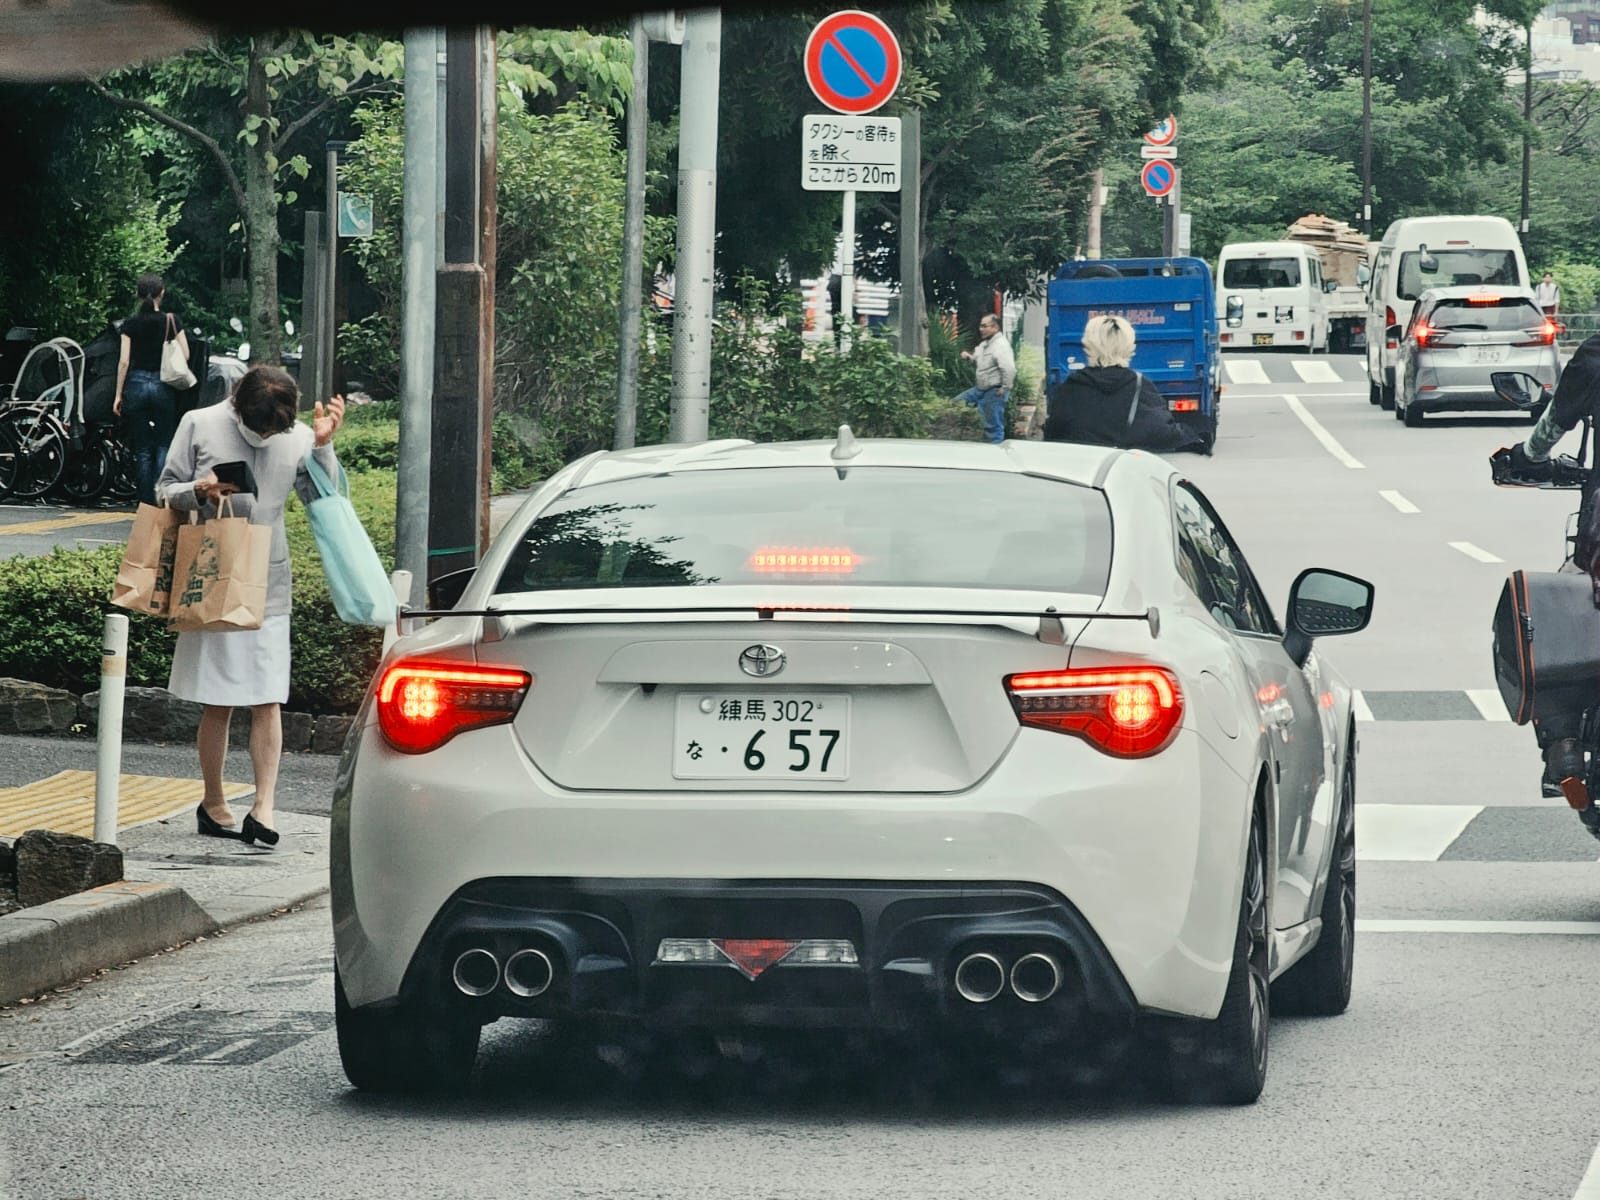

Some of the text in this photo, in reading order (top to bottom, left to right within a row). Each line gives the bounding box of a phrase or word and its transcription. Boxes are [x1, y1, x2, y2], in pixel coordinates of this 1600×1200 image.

[809, 123, 896, 142] タクシーの客待ち
[809, 144, 850, 161] を除く
[862, 166, 896, 185] 20m
[718, 699, 814, 722] 練馬 302
